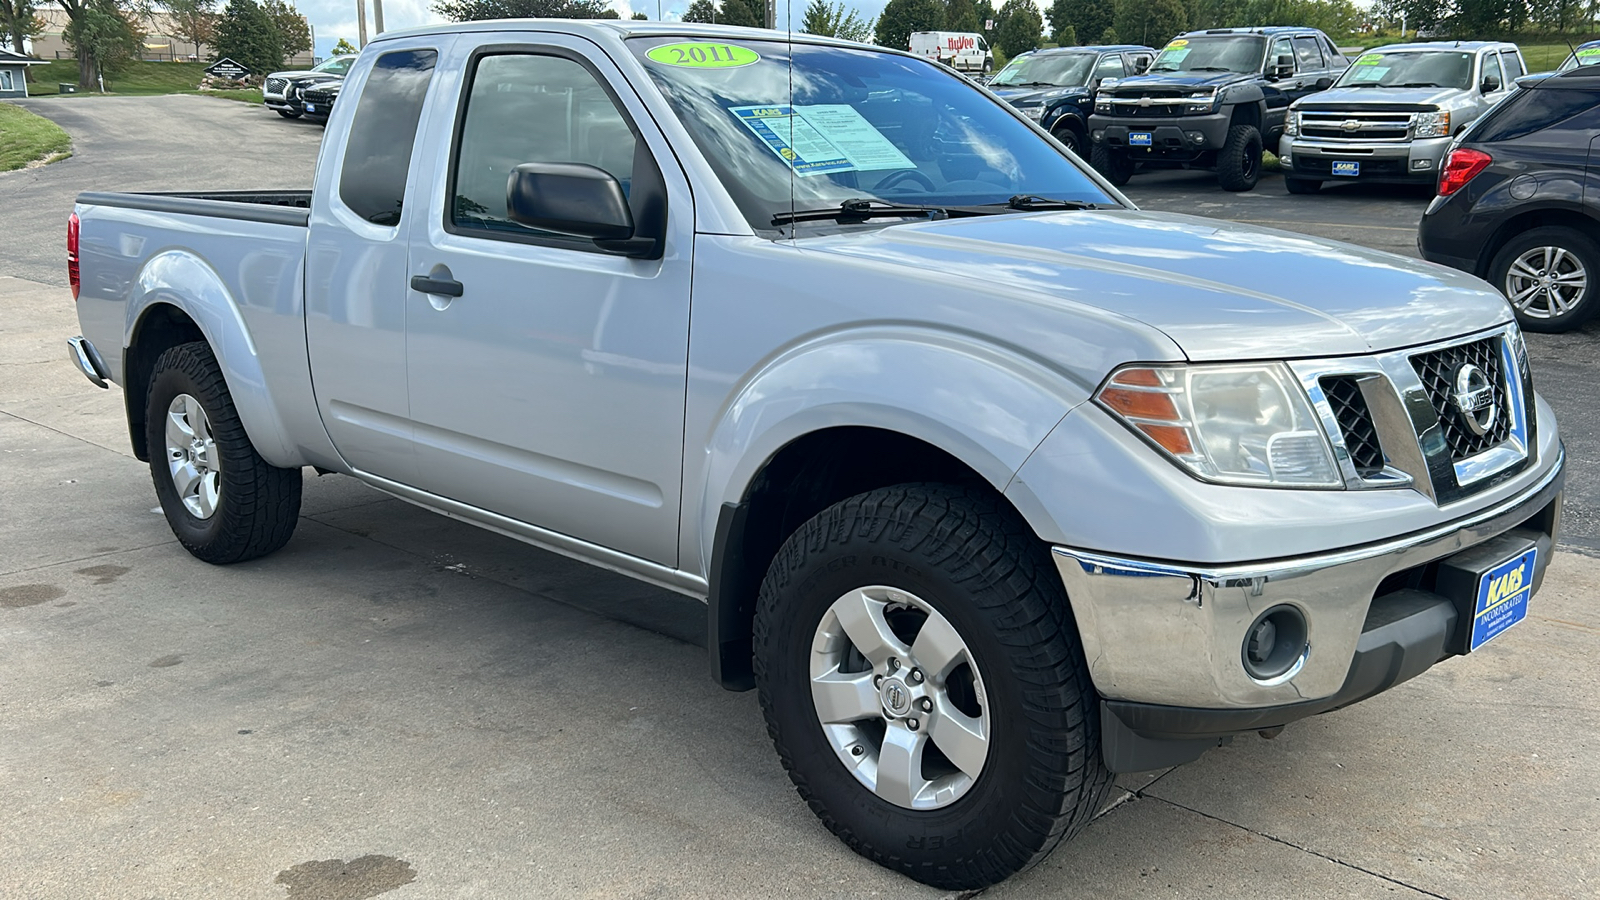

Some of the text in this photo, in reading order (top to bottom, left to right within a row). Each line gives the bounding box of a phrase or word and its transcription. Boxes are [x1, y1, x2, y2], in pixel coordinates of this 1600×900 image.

[669, 46, 738, 64] 2011
[1486, 563, 1525, 607] KARS
[1481, 594, 1522, 625] INCORPORATED
